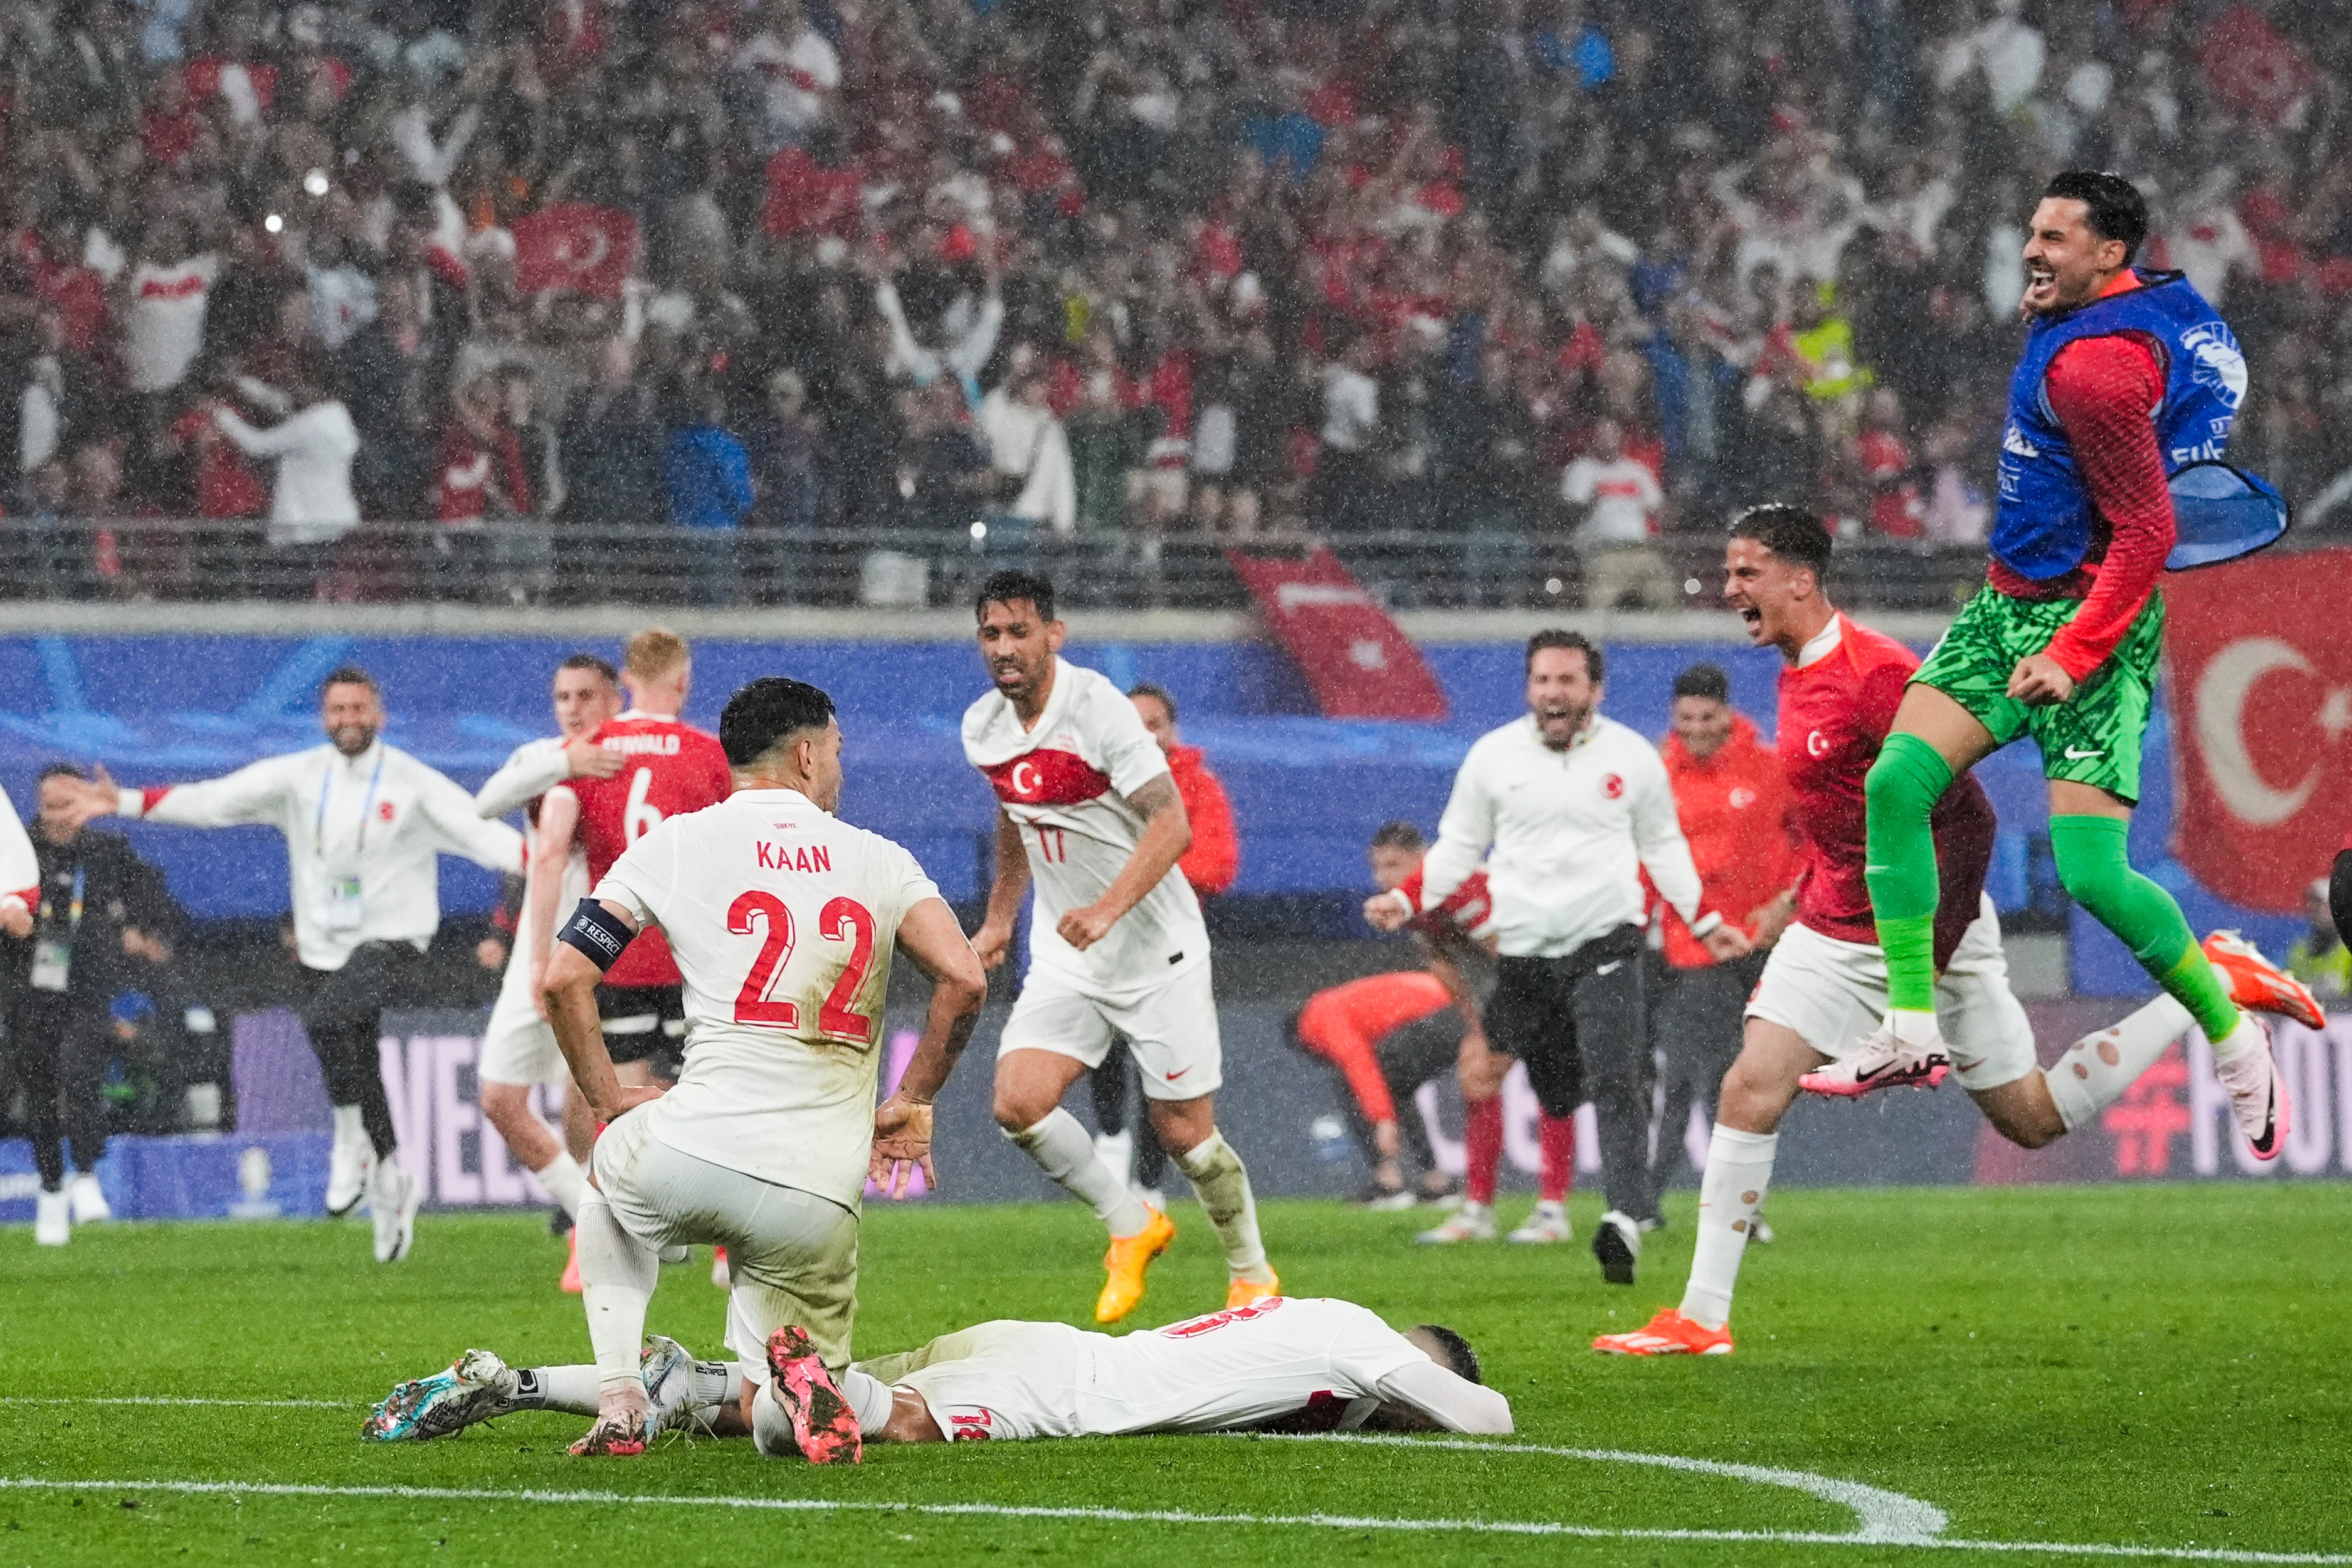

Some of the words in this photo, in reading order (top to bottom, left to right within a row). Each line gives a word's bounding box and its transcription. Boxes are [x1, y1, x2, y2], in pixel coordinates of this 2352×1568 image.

[624, 767, 663, 849] 6
[756, 841, 831, 873] KAAN
[587, 925, 620, 954] RESPECT
[727, 890, 877, 1043] 22
